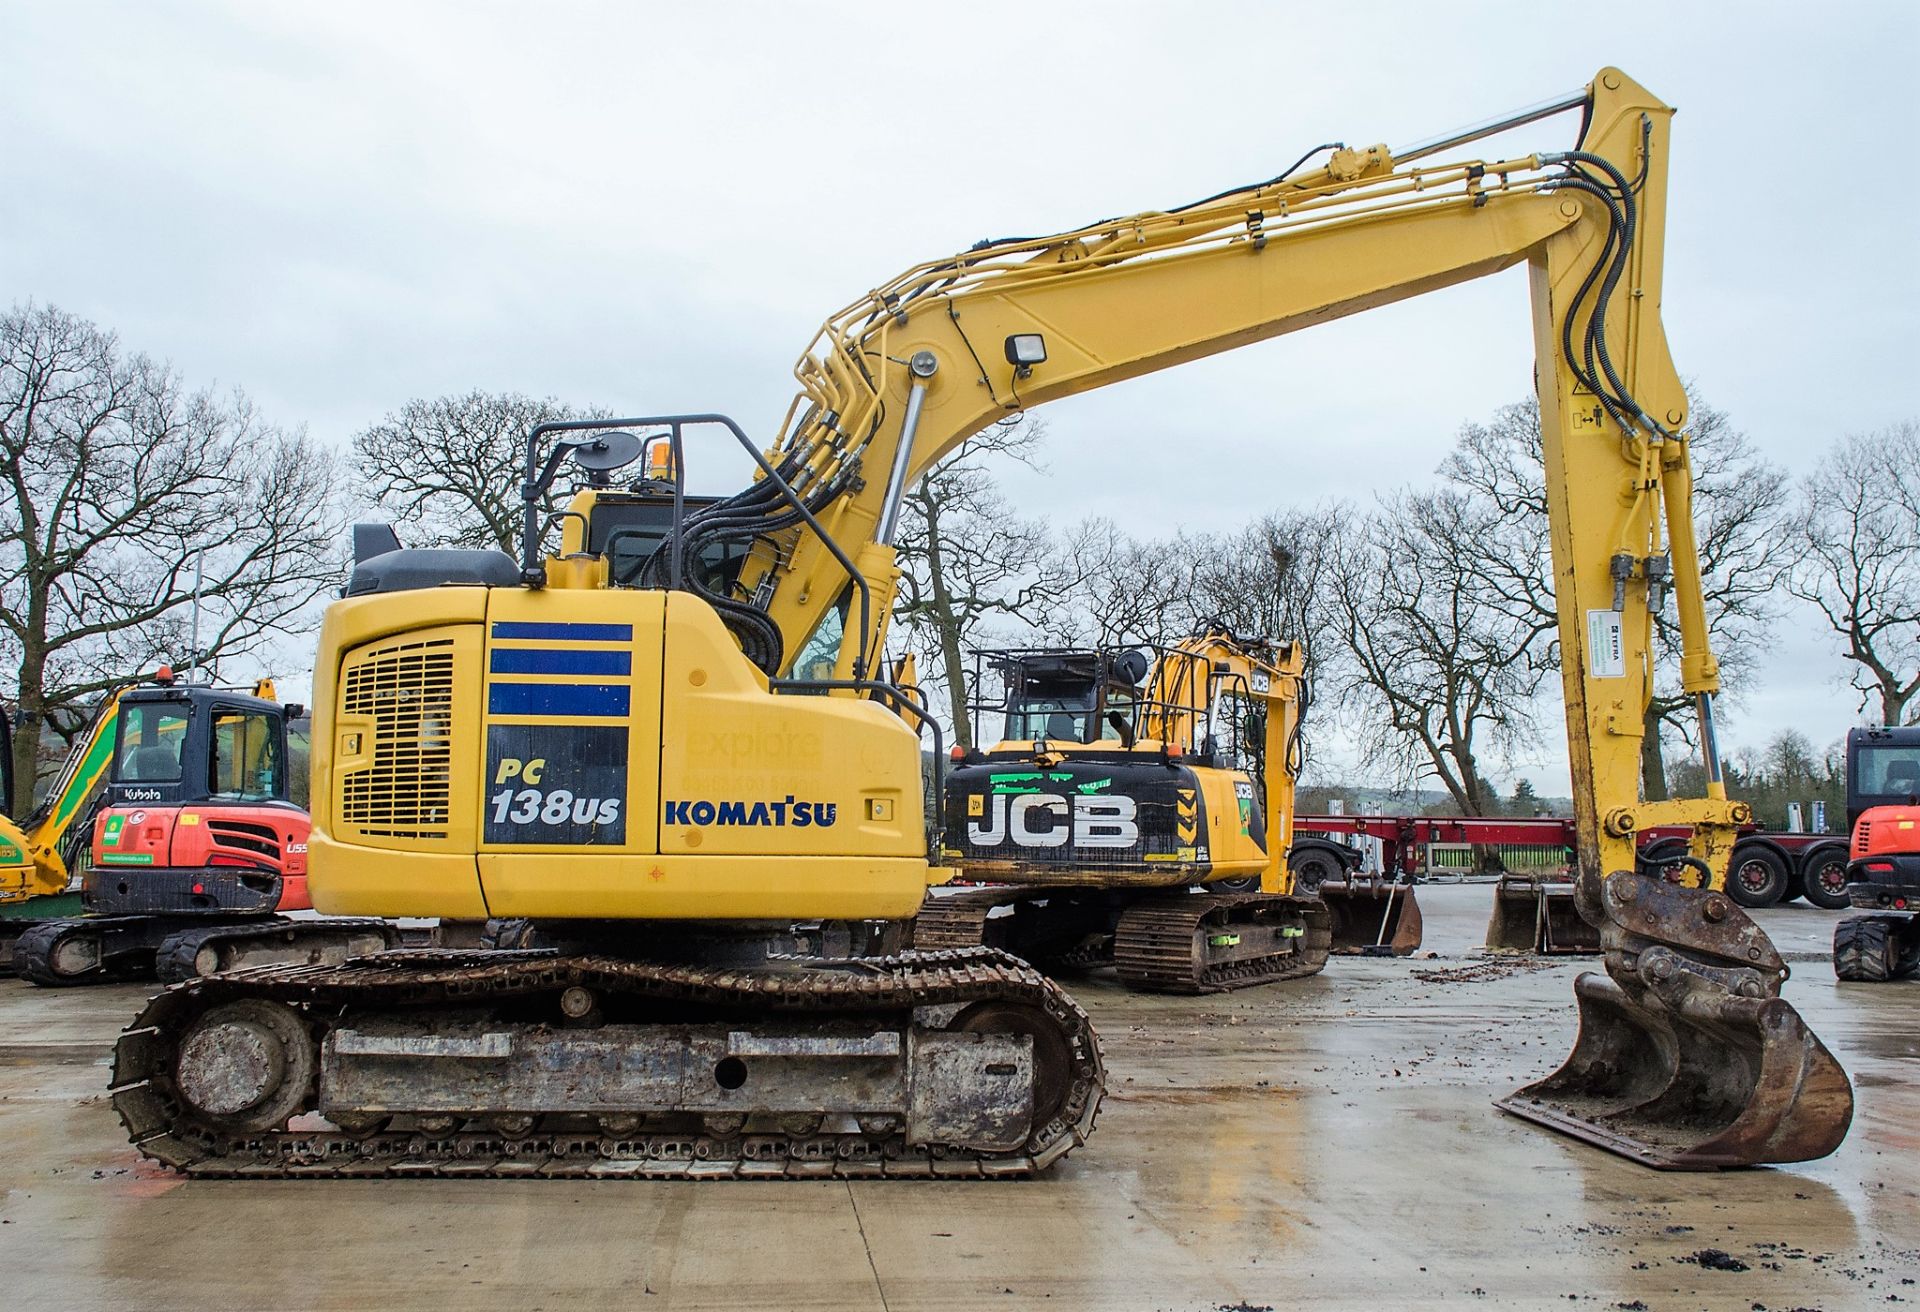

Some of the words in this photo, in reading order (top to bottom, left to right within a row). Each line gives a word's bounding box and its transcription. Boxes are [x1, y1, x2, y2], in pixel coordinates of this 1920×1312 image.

[1252, 674, 1269, 692] JCB
[495, 758, 546, 785] PC
[125, 788, 161, 800] Kubota
[1234, 783, 1253, 799] JCB
[665, 795, 837, 828] KOMATSU
[968, 794, 1139, 848] JCB
